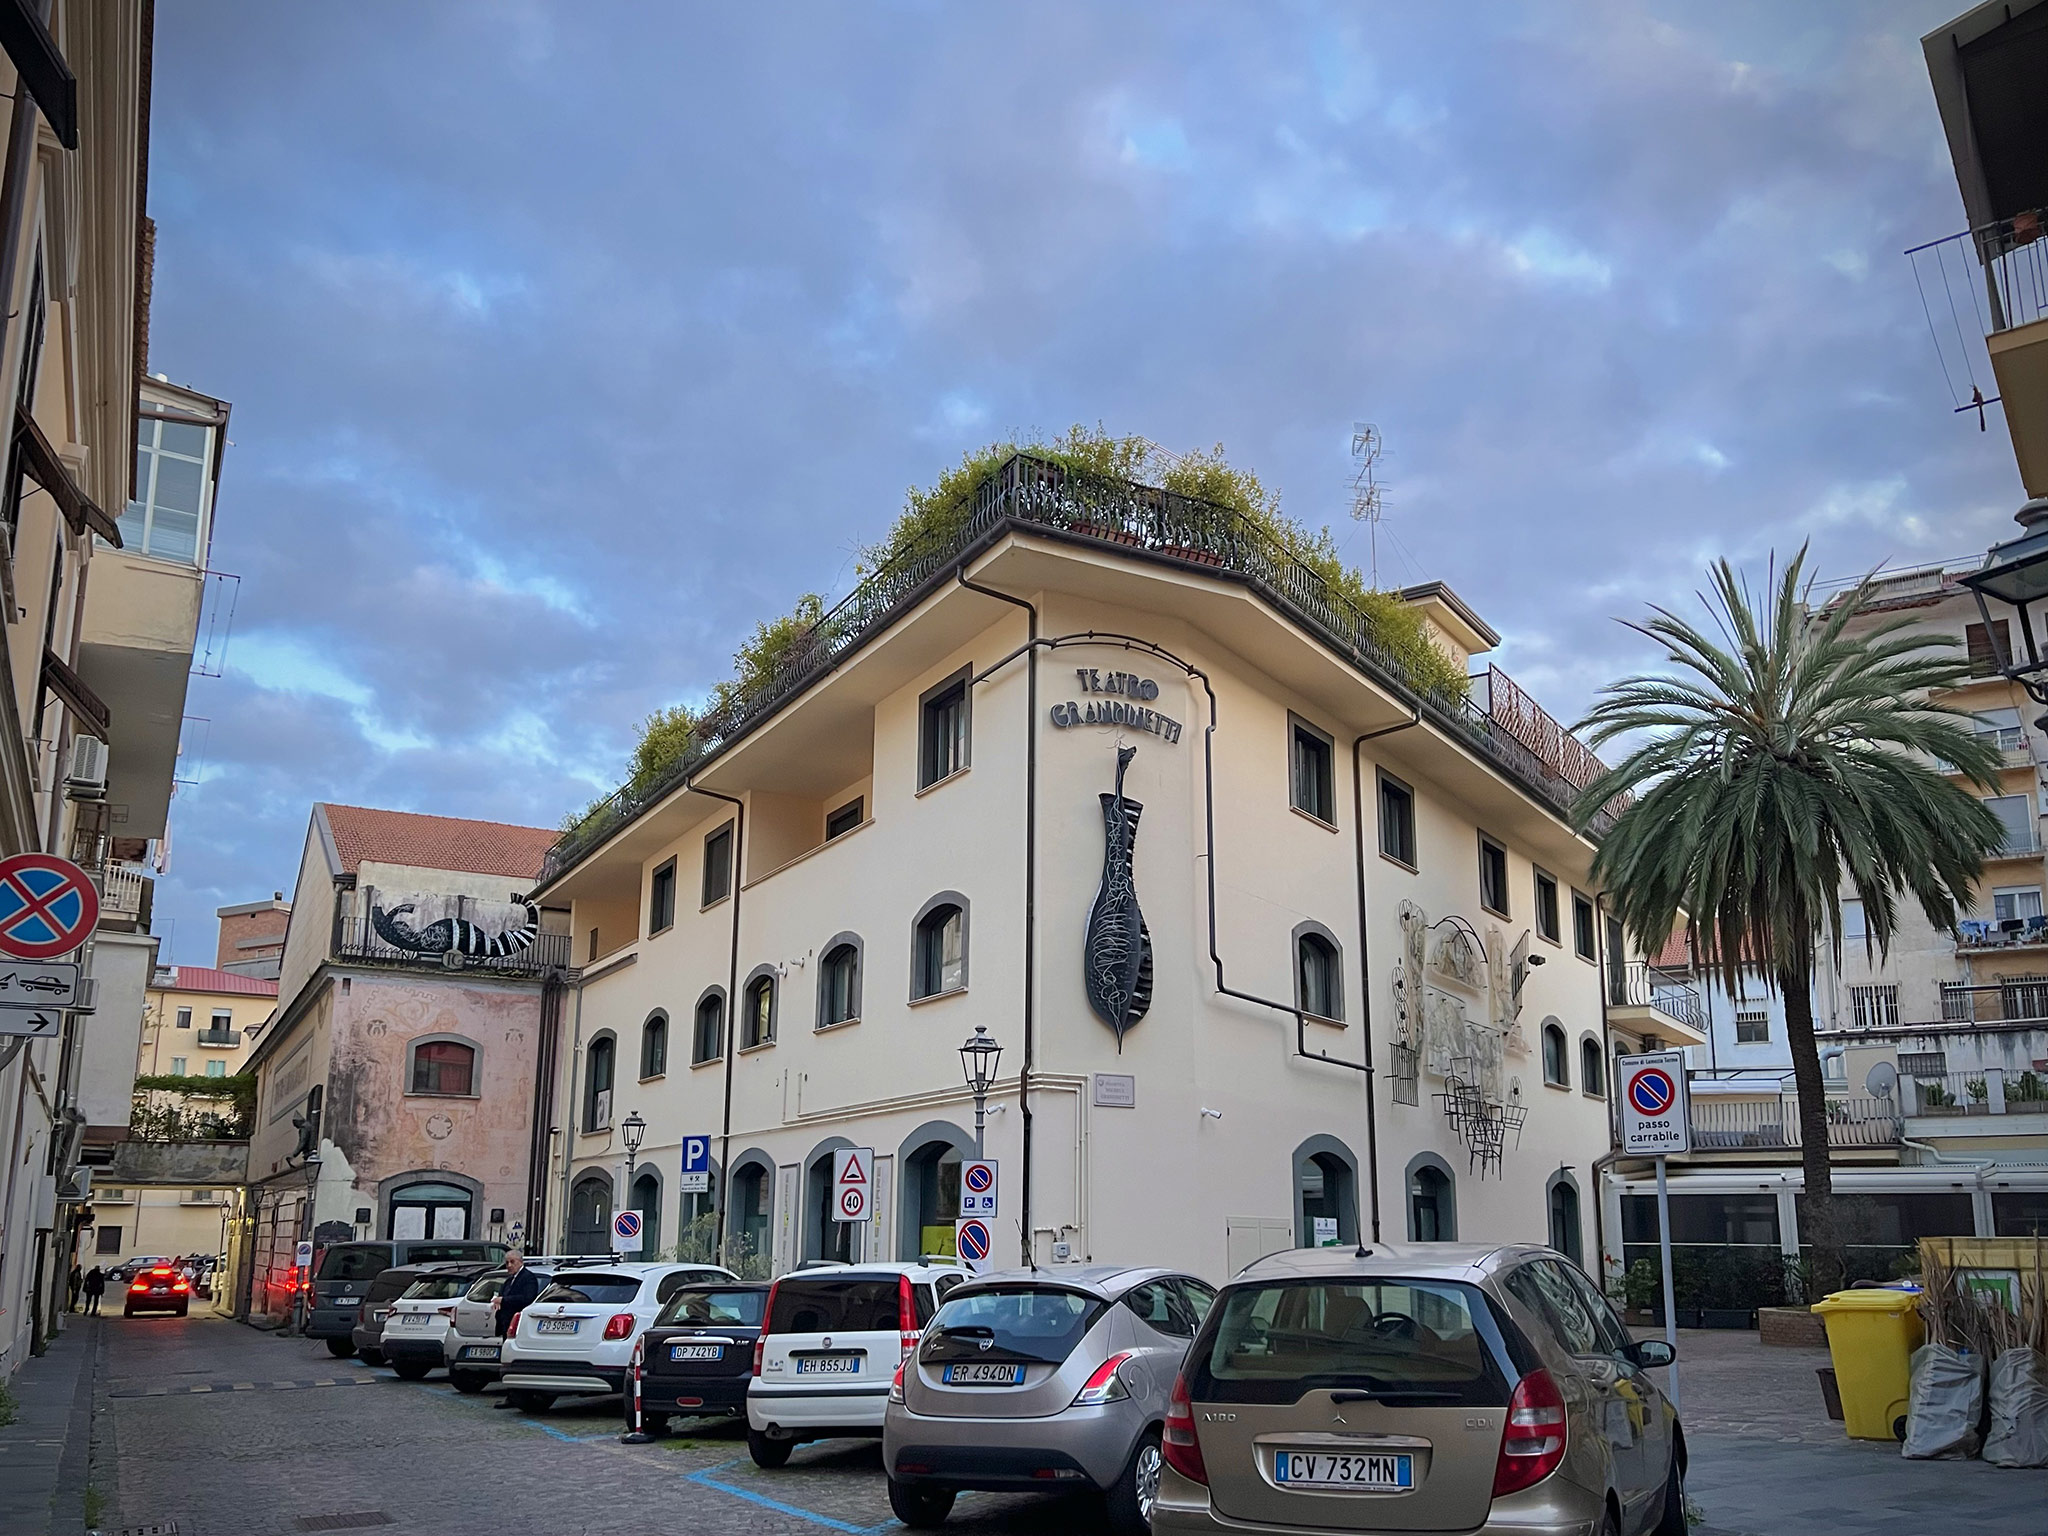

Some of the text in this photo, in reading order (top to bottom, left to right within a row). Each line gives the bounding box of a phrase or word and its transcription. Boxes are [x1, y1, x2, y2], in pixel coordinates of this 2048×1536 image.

[1076, 668, 1159, 701] TEATRO
[1050, 700, 1183, 745] GRANDINETTI
[1638, 1120, 1670, 1131] passo
[1630, 1131, 1680, 1142] carrabile
[687, 1139, 704, 1170] P
[846, 1195, 859, 1209] 40
[966, 1198, 973, 1207] P
[676, 1347, 718, 1357] DP 742YB
[803, 1359, 854, 1372] EH 855JJ
[952, 1366, 969, 1381] ER
[973, 1366, 1016, 1381] 494DN
[1291, 1455, 1317, 1479] CV
[1326, 1456, 1395, 1482] 732MN
